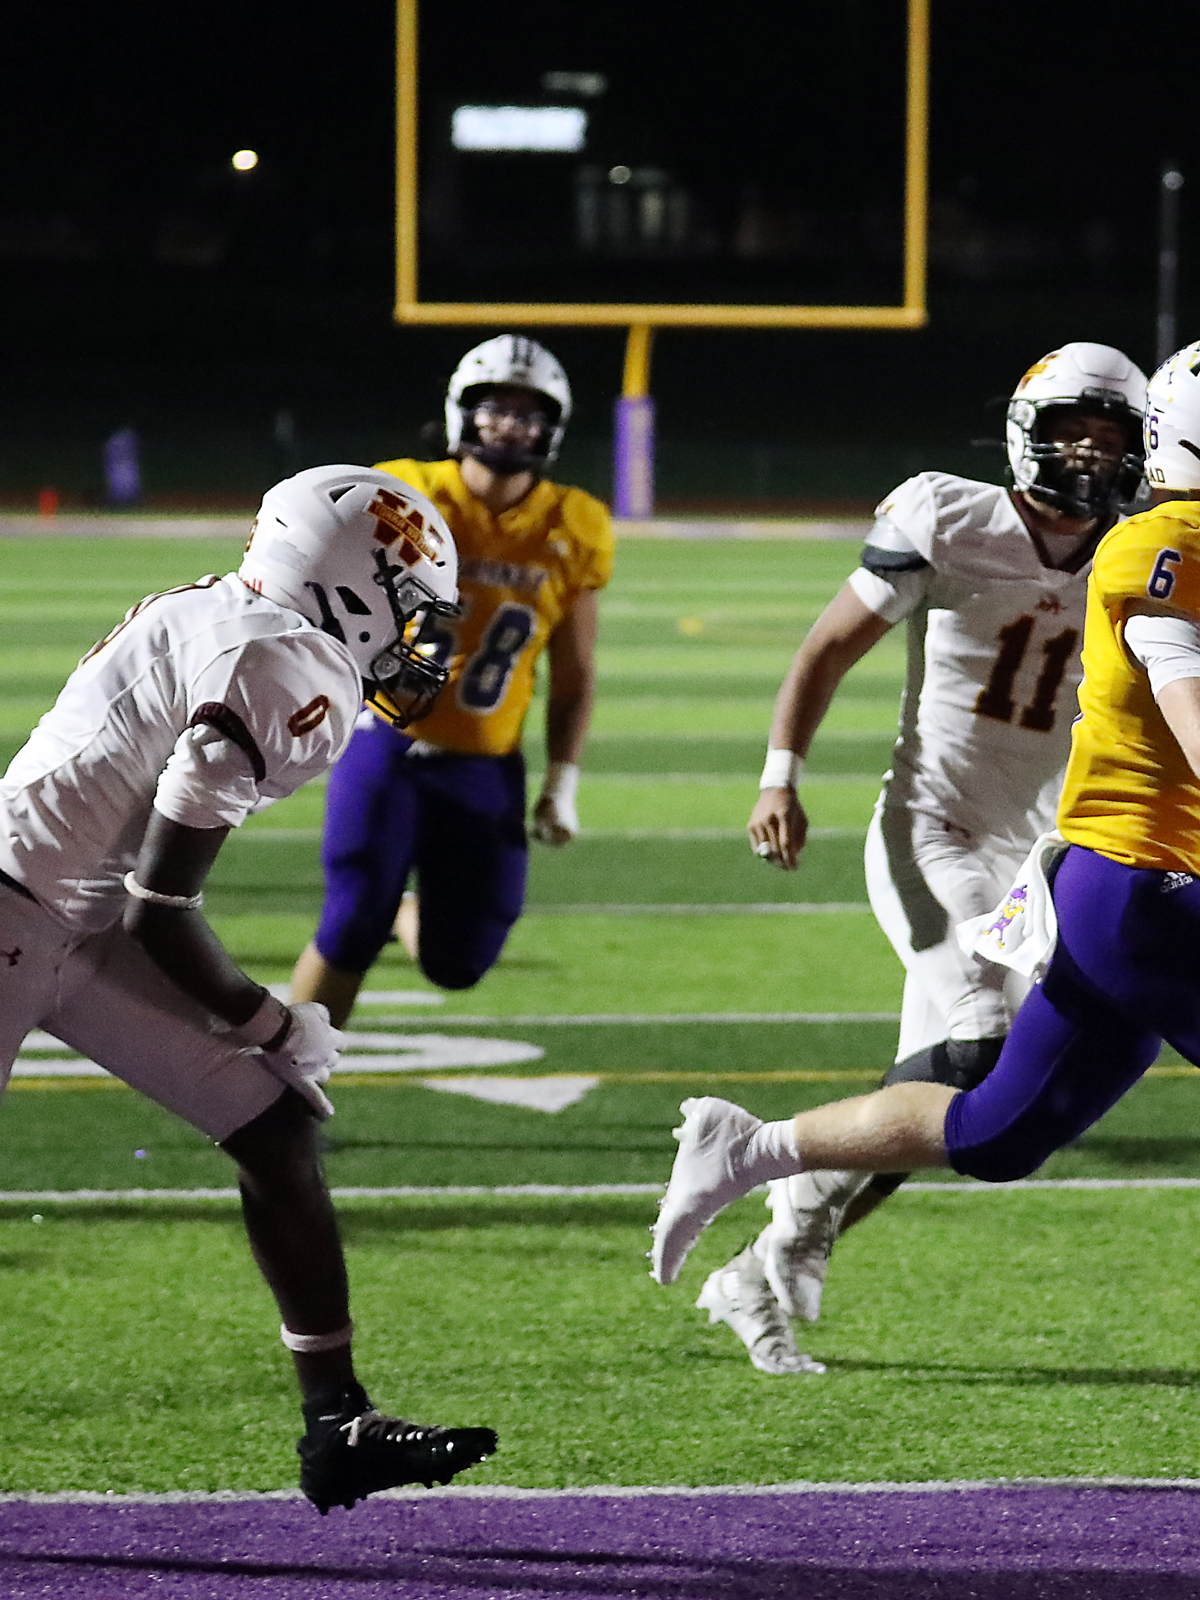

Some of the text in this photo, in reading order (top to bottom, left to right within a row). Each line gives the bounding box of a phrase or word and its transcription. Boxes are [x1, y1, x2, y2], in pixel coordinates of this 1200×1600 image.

[1147, 547, 1181, 599] 6
[971, 616, 1078, 732] 11
[287, 694, 330, 737] 0
